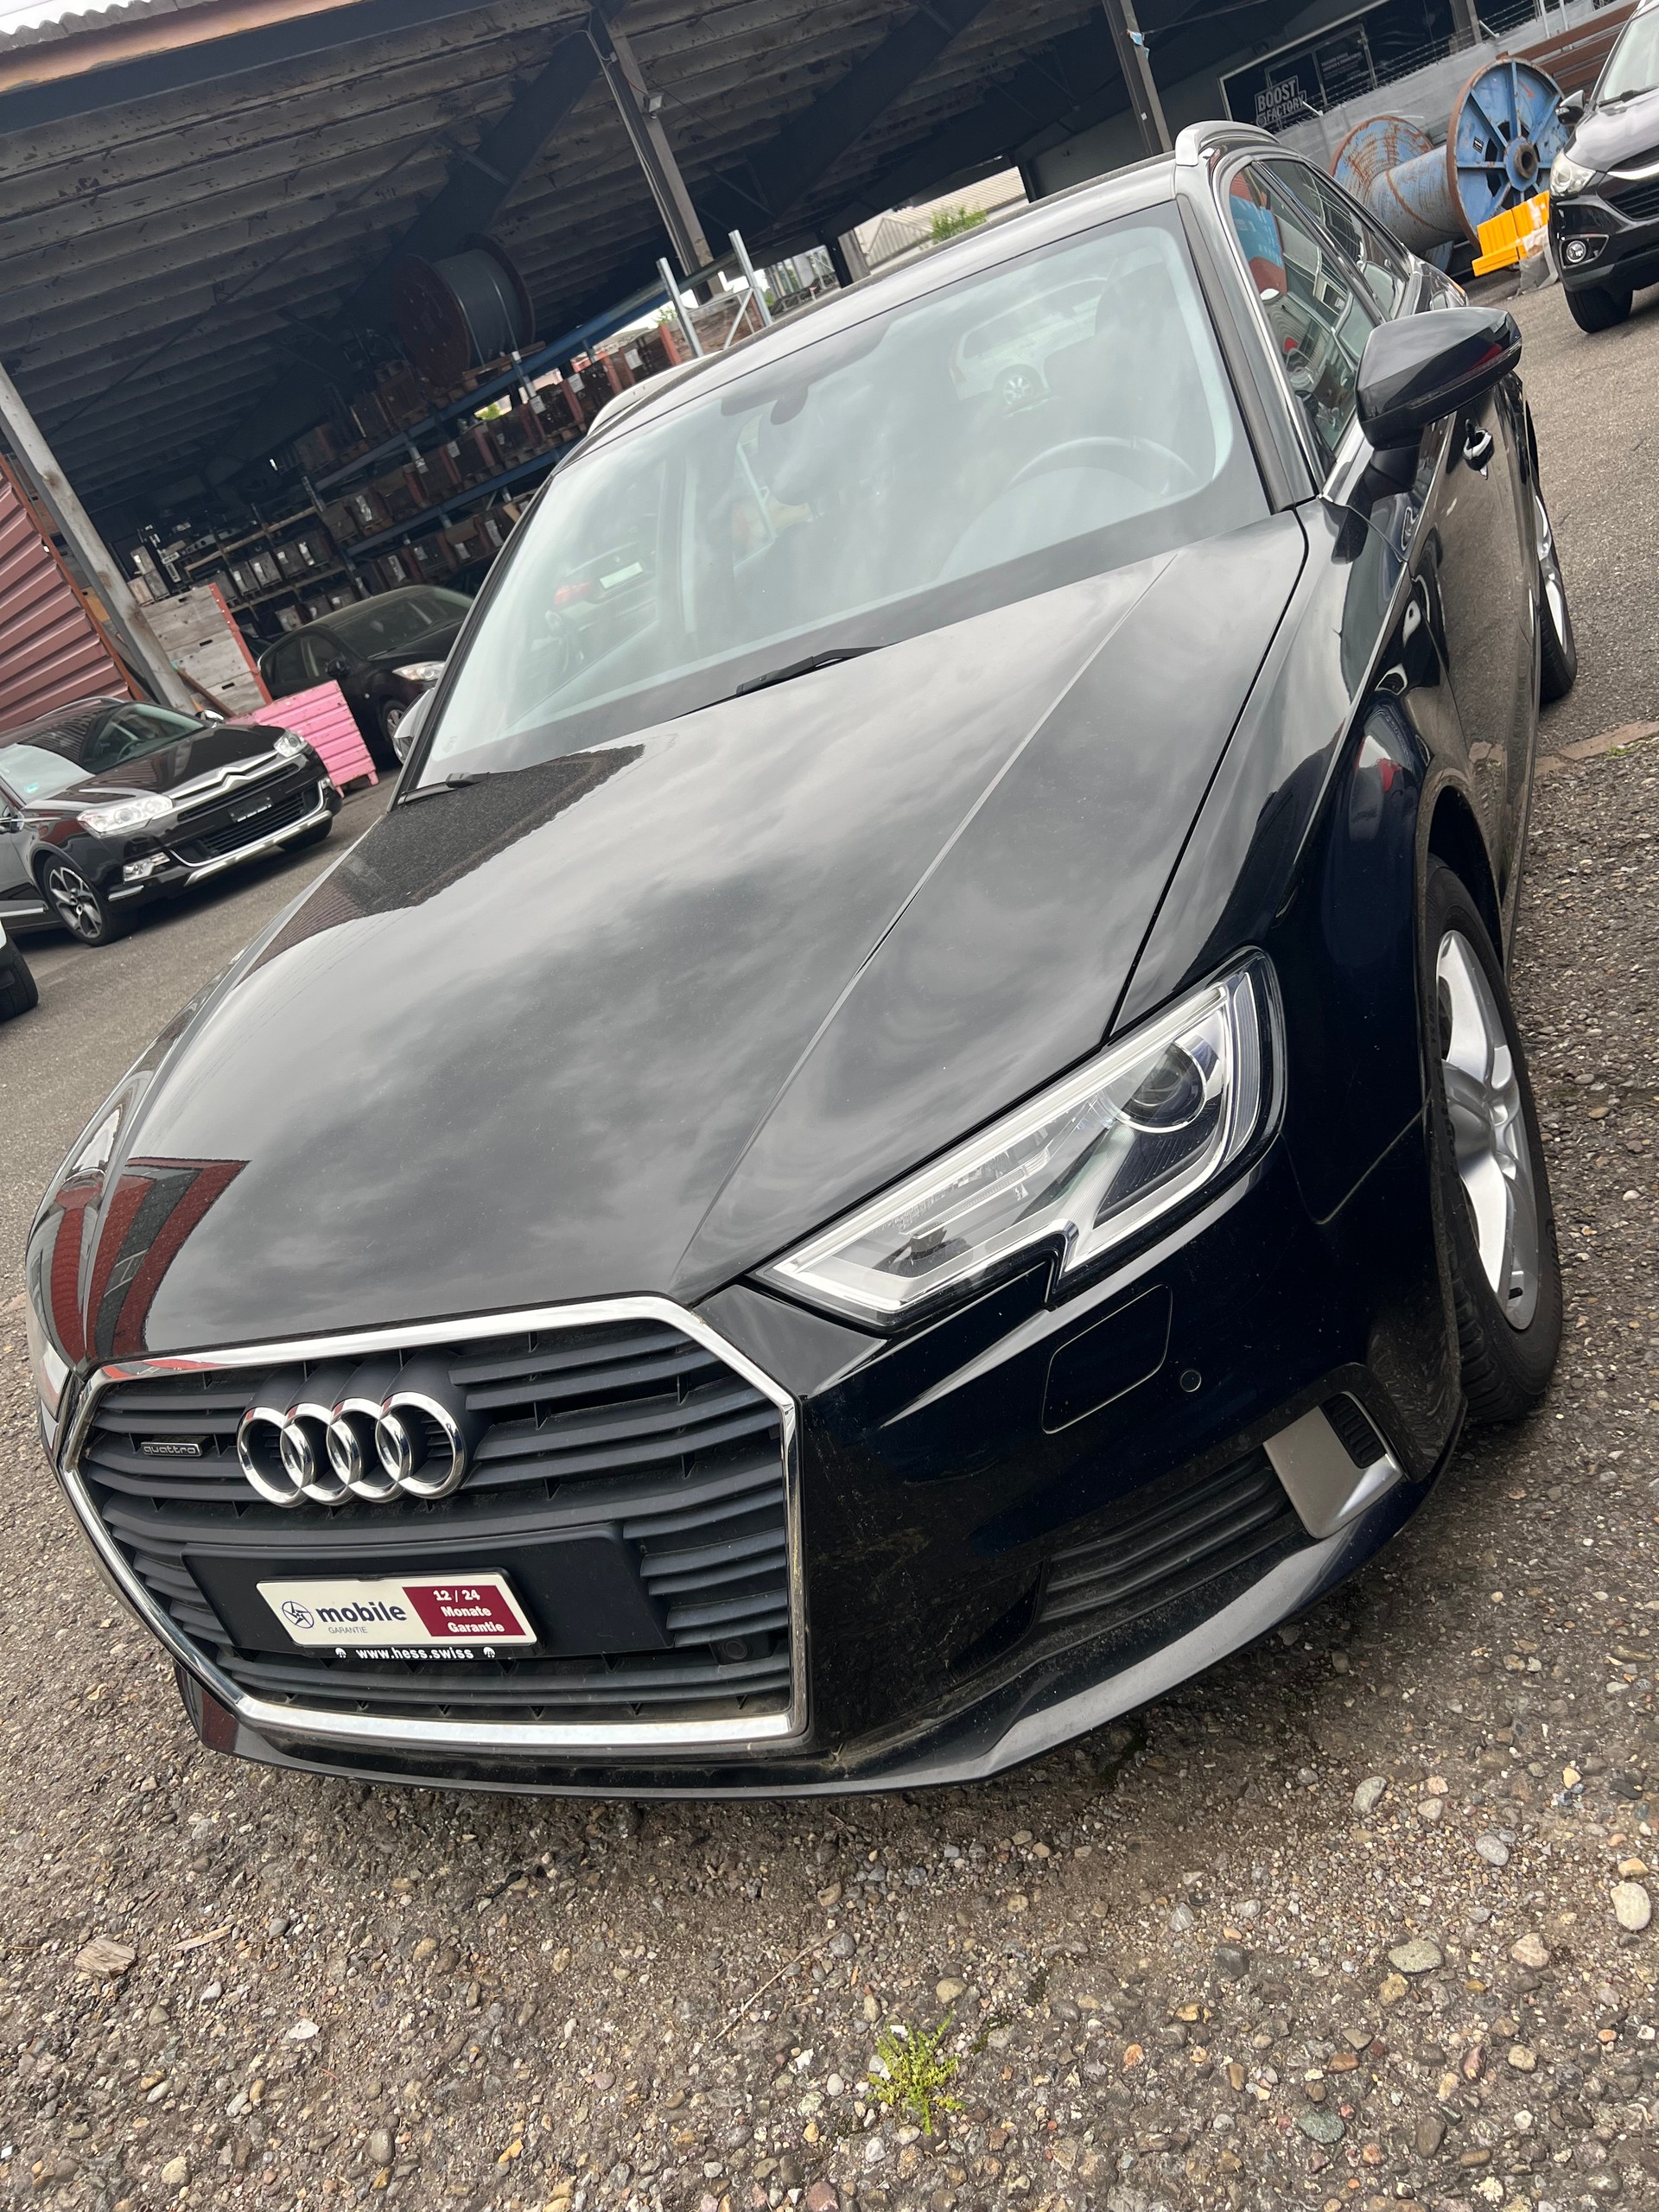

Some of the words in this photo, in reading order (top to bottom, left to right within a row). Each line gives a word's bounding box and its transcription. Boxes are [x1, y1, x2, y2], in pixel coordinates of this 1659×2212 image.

[1257, 79, 1295, 112] BOOST
[1267, 94, 1304, 121] FACTORY
[433, 1590, 452, 1600] 12
[461, 1589, 481, 1600] 24
[315, 1601, 407, 1622] mobile
[441, 1605, 492, 1617] Monate
[448, 1622, 505, 1632] Garantie
[355, 1647, 474, 1659] www.hess.swiss
